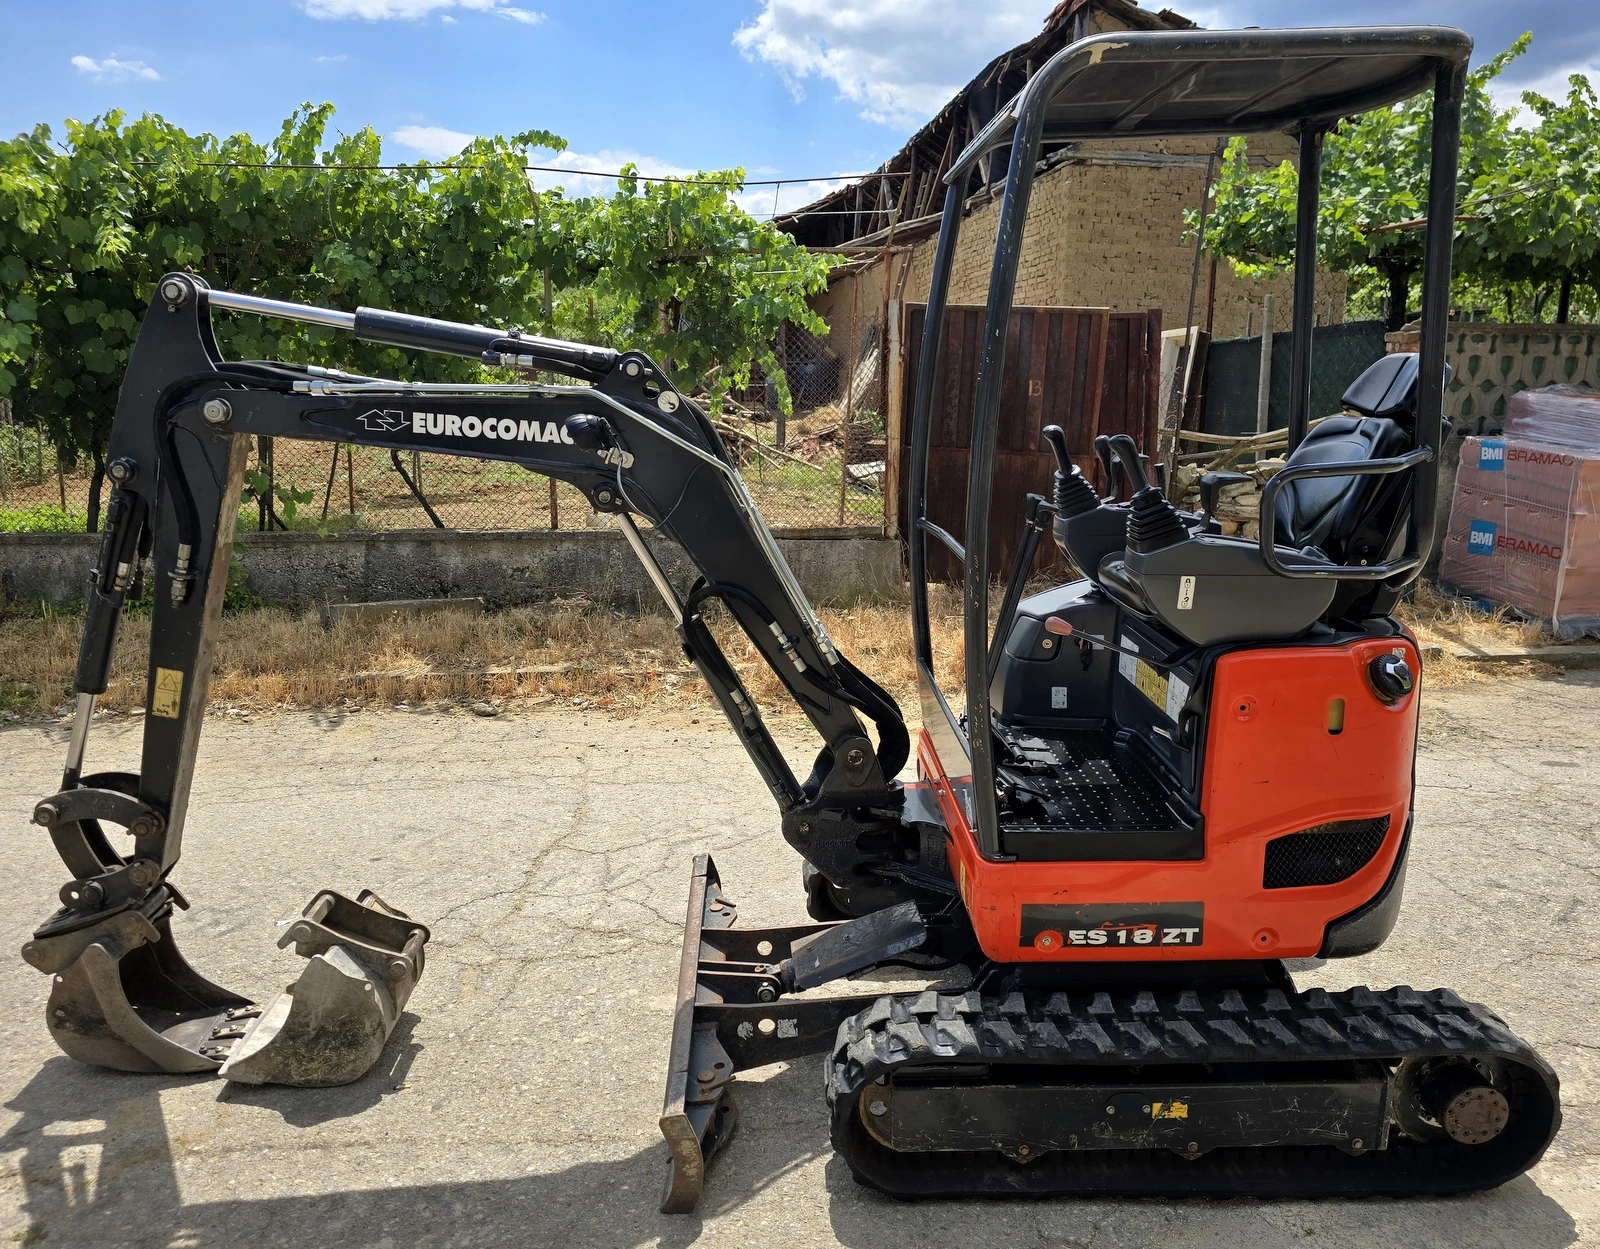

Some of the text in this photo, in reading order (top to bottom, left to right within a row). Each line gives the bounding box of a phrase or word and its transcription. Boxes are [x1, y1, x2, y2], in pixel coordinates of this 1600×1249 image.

[1481, 446, 1504, 461] BMI
[1469, 530, 1494, 547] BMI
[1068, 929, 1108, 945] ES
[1161, 927, 1200, 944] ZT
